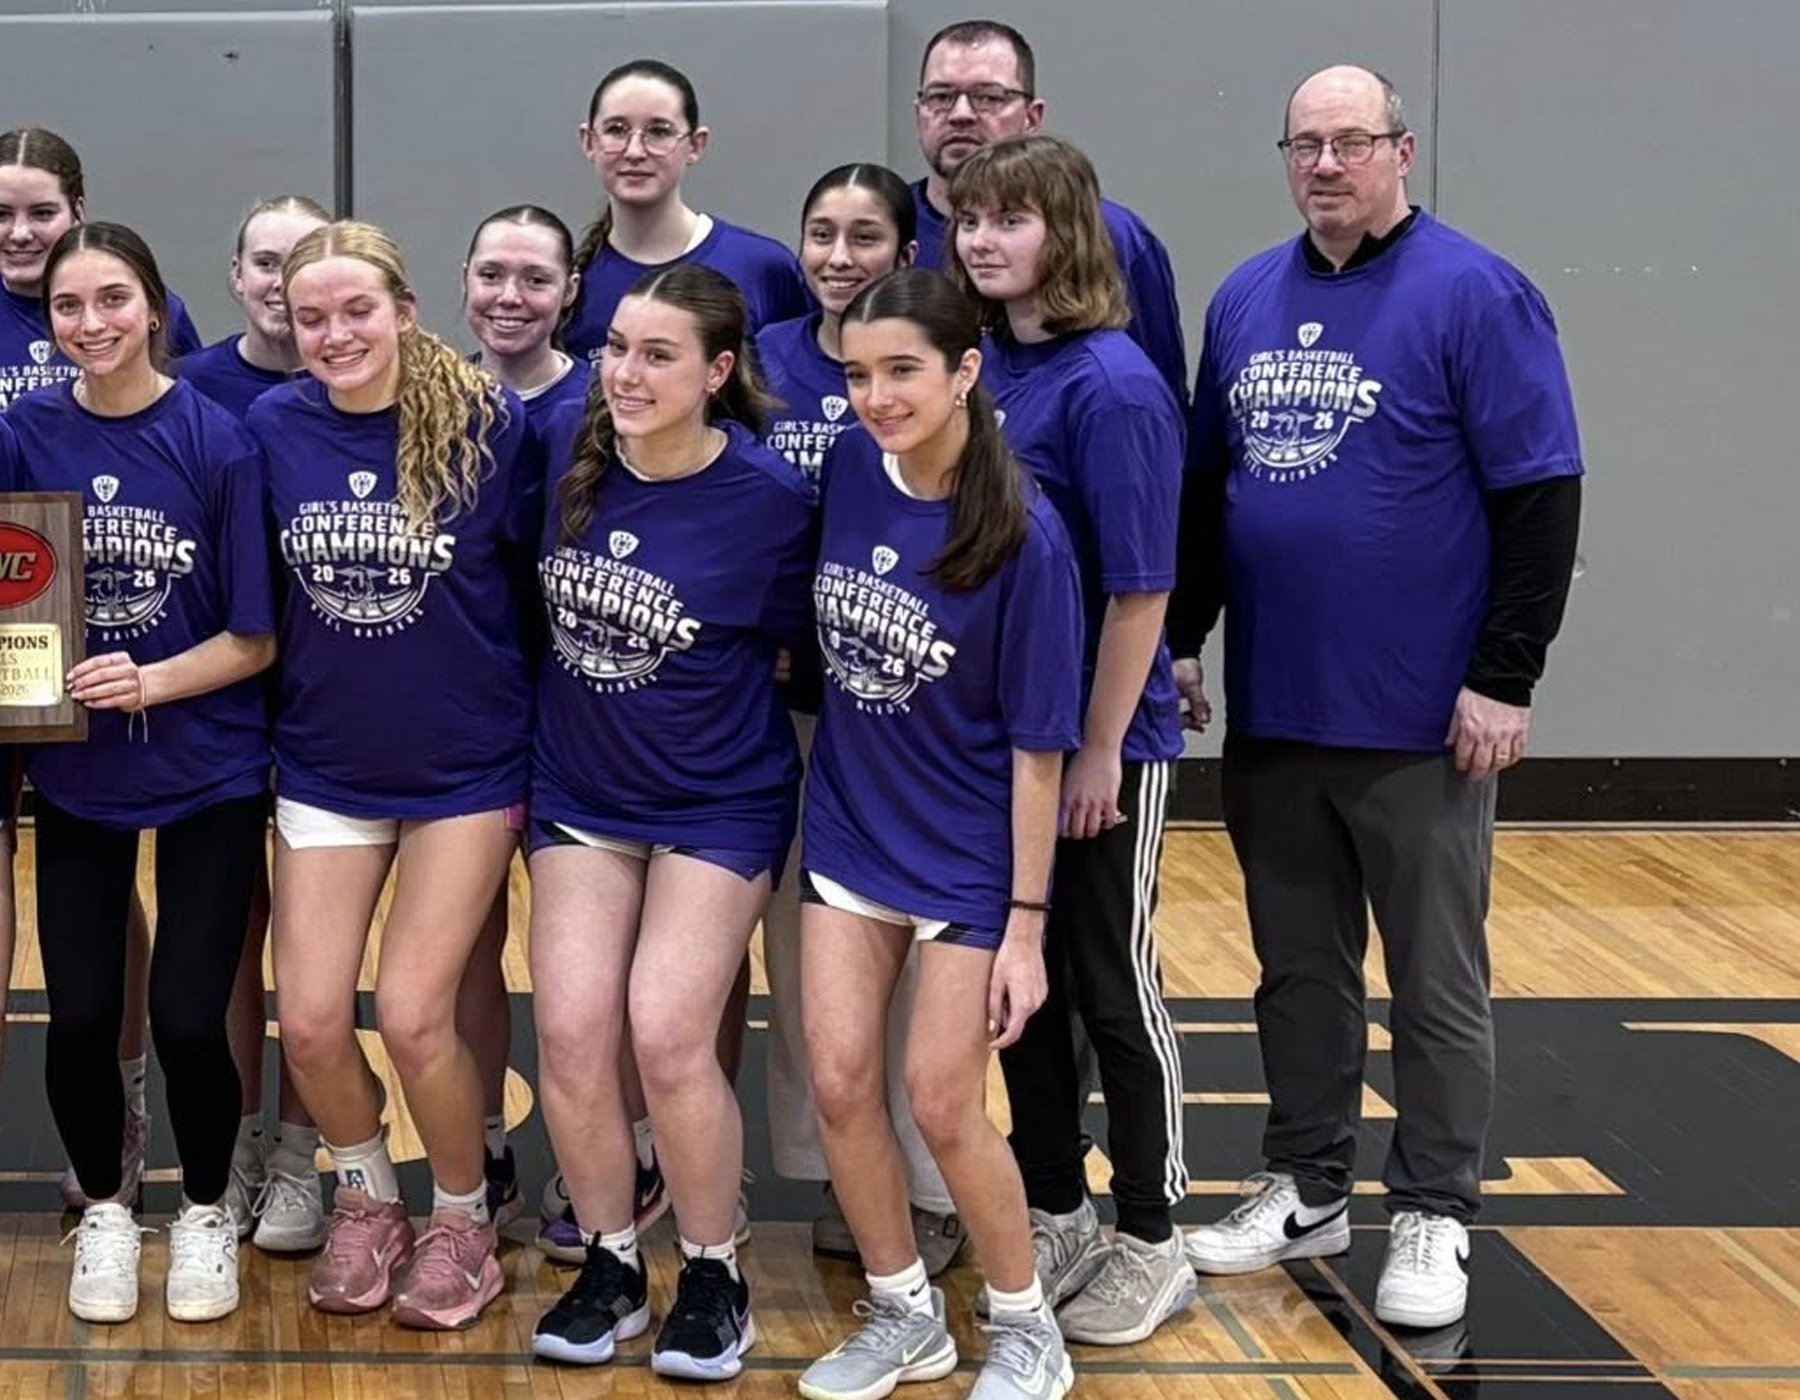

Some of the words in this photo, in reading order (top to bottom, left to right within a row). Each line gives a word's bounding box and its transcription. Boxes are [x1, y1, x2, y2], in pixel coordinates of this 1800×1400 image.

[1250, 350, 1285, 364] GIRL'S
[1288, 349, 1354, 364] BASKETBALL
[1240, 362, 1363, 383] CONFERENCE
[1229, 380, 1382, 418] CHAMPIONS
[1251, 411, 1269, 429] 20
[1314, 411, 1334, 430] 26
[87, 506, 166, 523] BASKETBALL
[299, 501, 338, 515] GIRL'S
[82, 518, 178, 543] FERENCE
[291, 514, 436, 538] CONFERENE
[83, 537, 197, 575] MPIONS
[280, 528, 456, 571] CHAMPIONS
[133, 570, 156, 588] 26
[312, 565, 335, 582] 20
[388, 568, 411, 585] 26
[544, 556, 684, 619] CONFERENCE
[594, 555, 675, 597] BASKETBALL
[857, 571, 929, 617] BASKETBALL
[815, 574, 937, 640] CONFERENCE
[556, 607, 577, 629] 20
[627, 632, 650, 650] 26
[814, 593, 956, 677] HAMPIONS
[882, 655, 905, 676] 26
